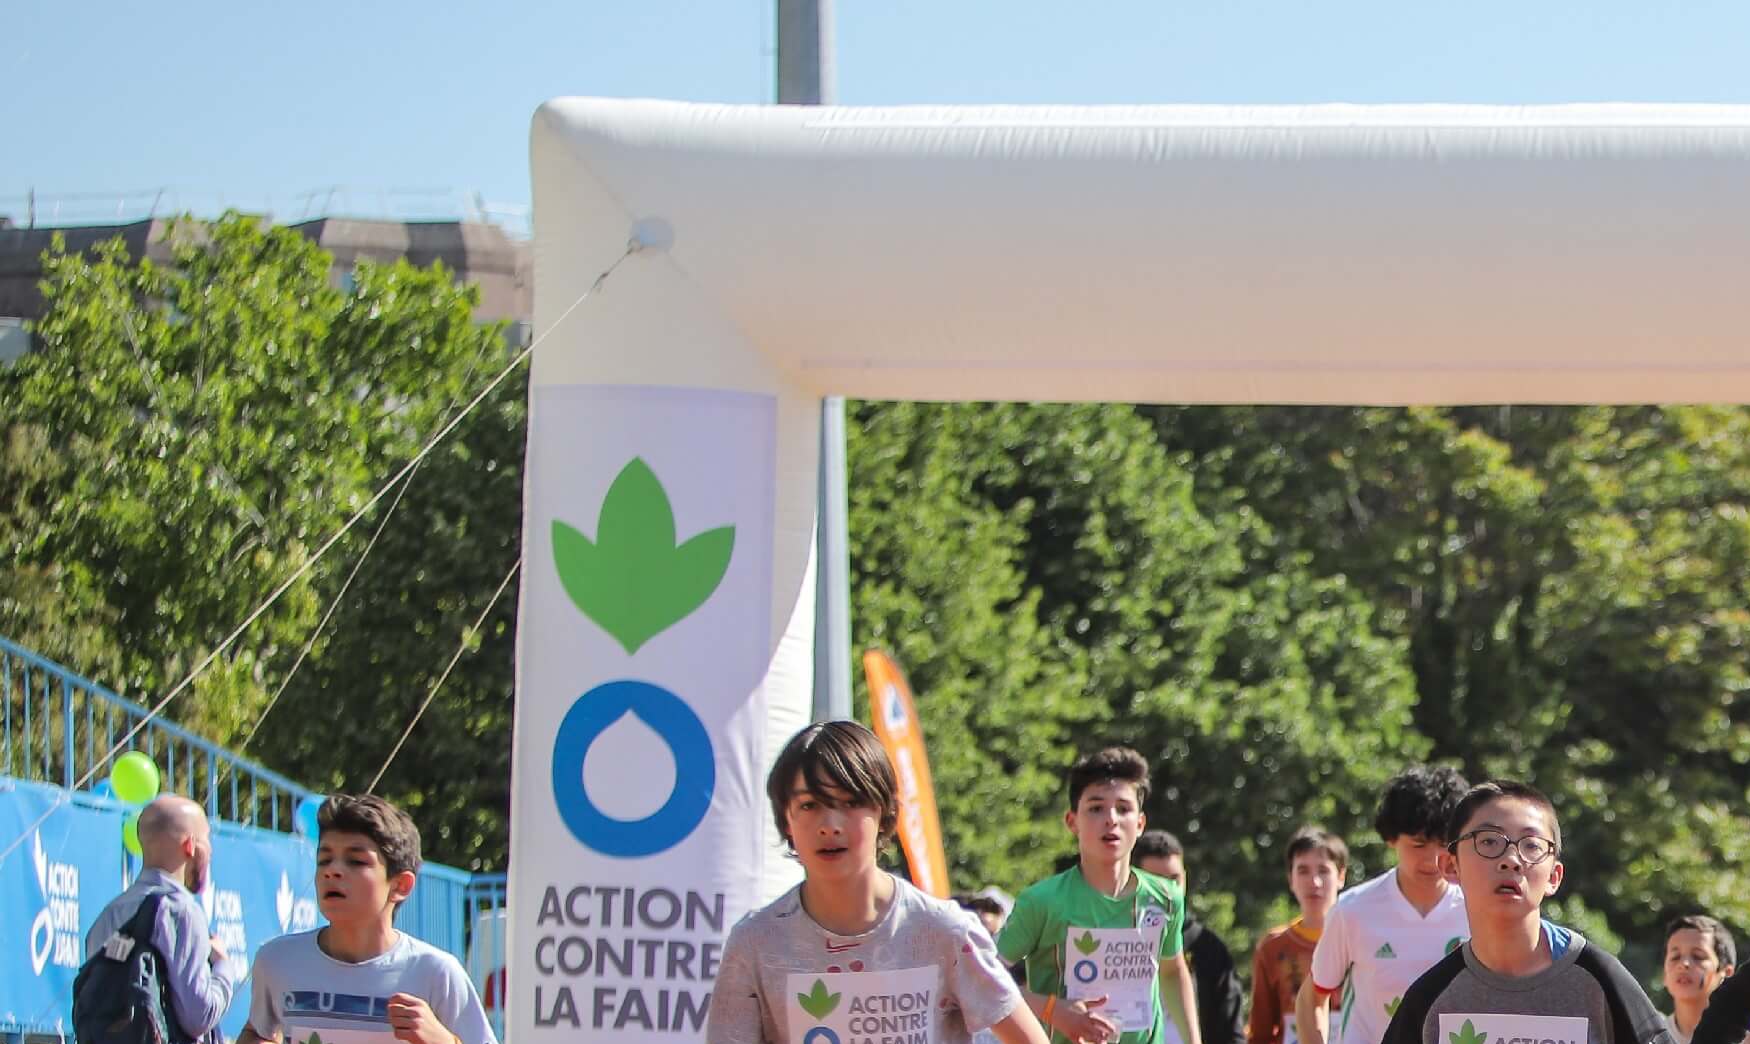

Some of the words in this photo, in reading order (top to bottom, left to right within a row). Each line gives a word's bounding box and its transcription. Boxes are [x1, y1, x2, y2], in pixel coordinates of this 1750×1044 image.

[537, 885, 725, 932] ACTION
[535, 936, 722, 982] CONTRE
[1105, 942, 1153, 954] ACTION
[1104, 968, 1120, 981] LA
[1122, 967, 1153, 980] FAIM
[534, 985, 581, 1029] LA
[592, 987, 712, 1033] FAIM
[848, 990, 930, 1014] ACTION
[848, 1011, 927, 1035] CONTRE
